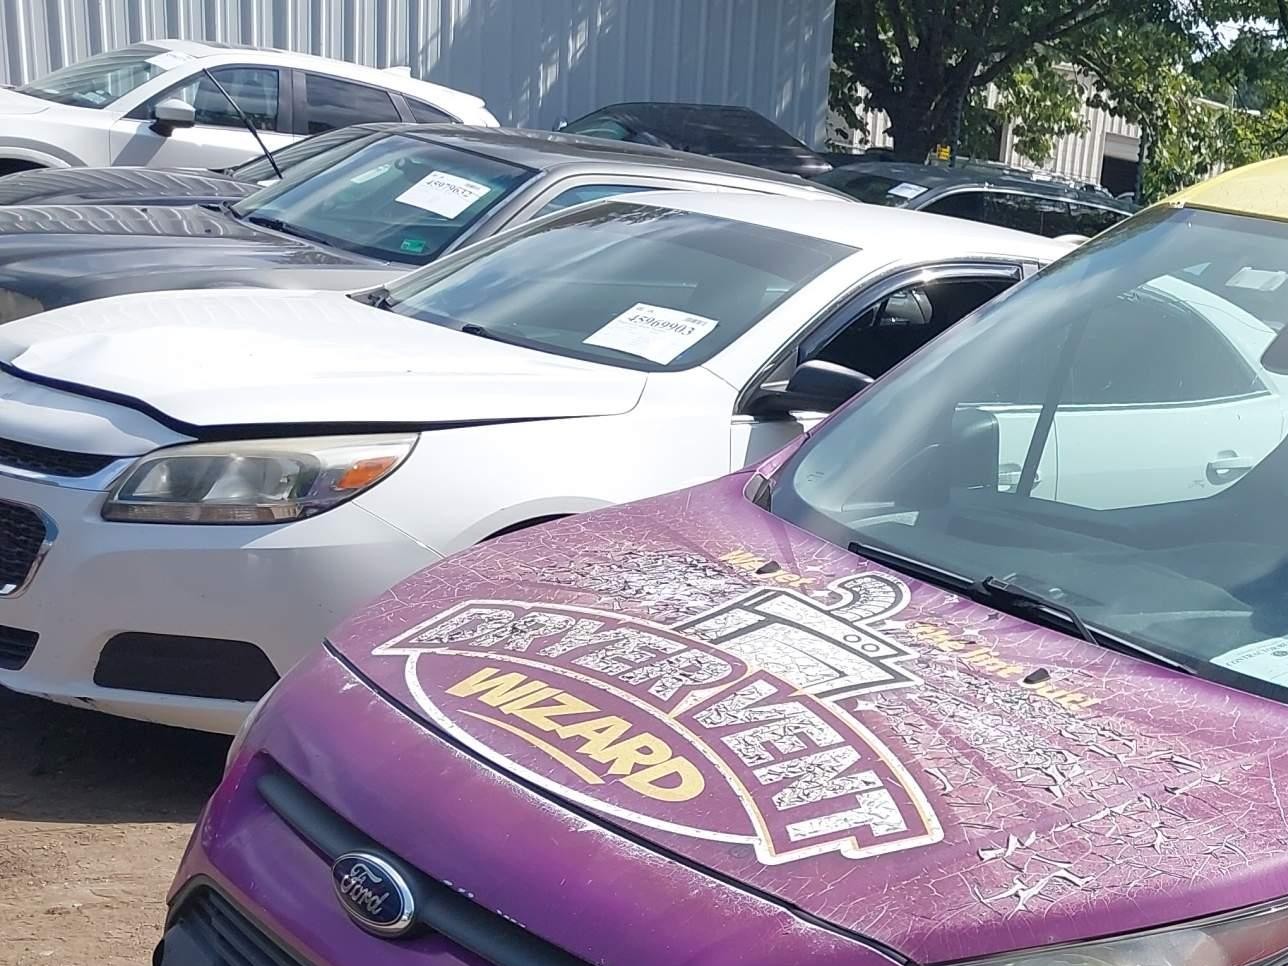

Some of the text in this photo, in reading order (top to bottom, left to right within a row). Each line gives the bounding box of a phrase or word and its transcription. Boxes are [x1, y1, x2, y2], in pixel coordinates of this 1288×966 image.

[907, 622, 1108, 711] the lint ut!
[408, 607, 908, 843] DRYER VENT
[445, 666, 706, 803] WIZARD
[340, 863, 390, 915] Ford
